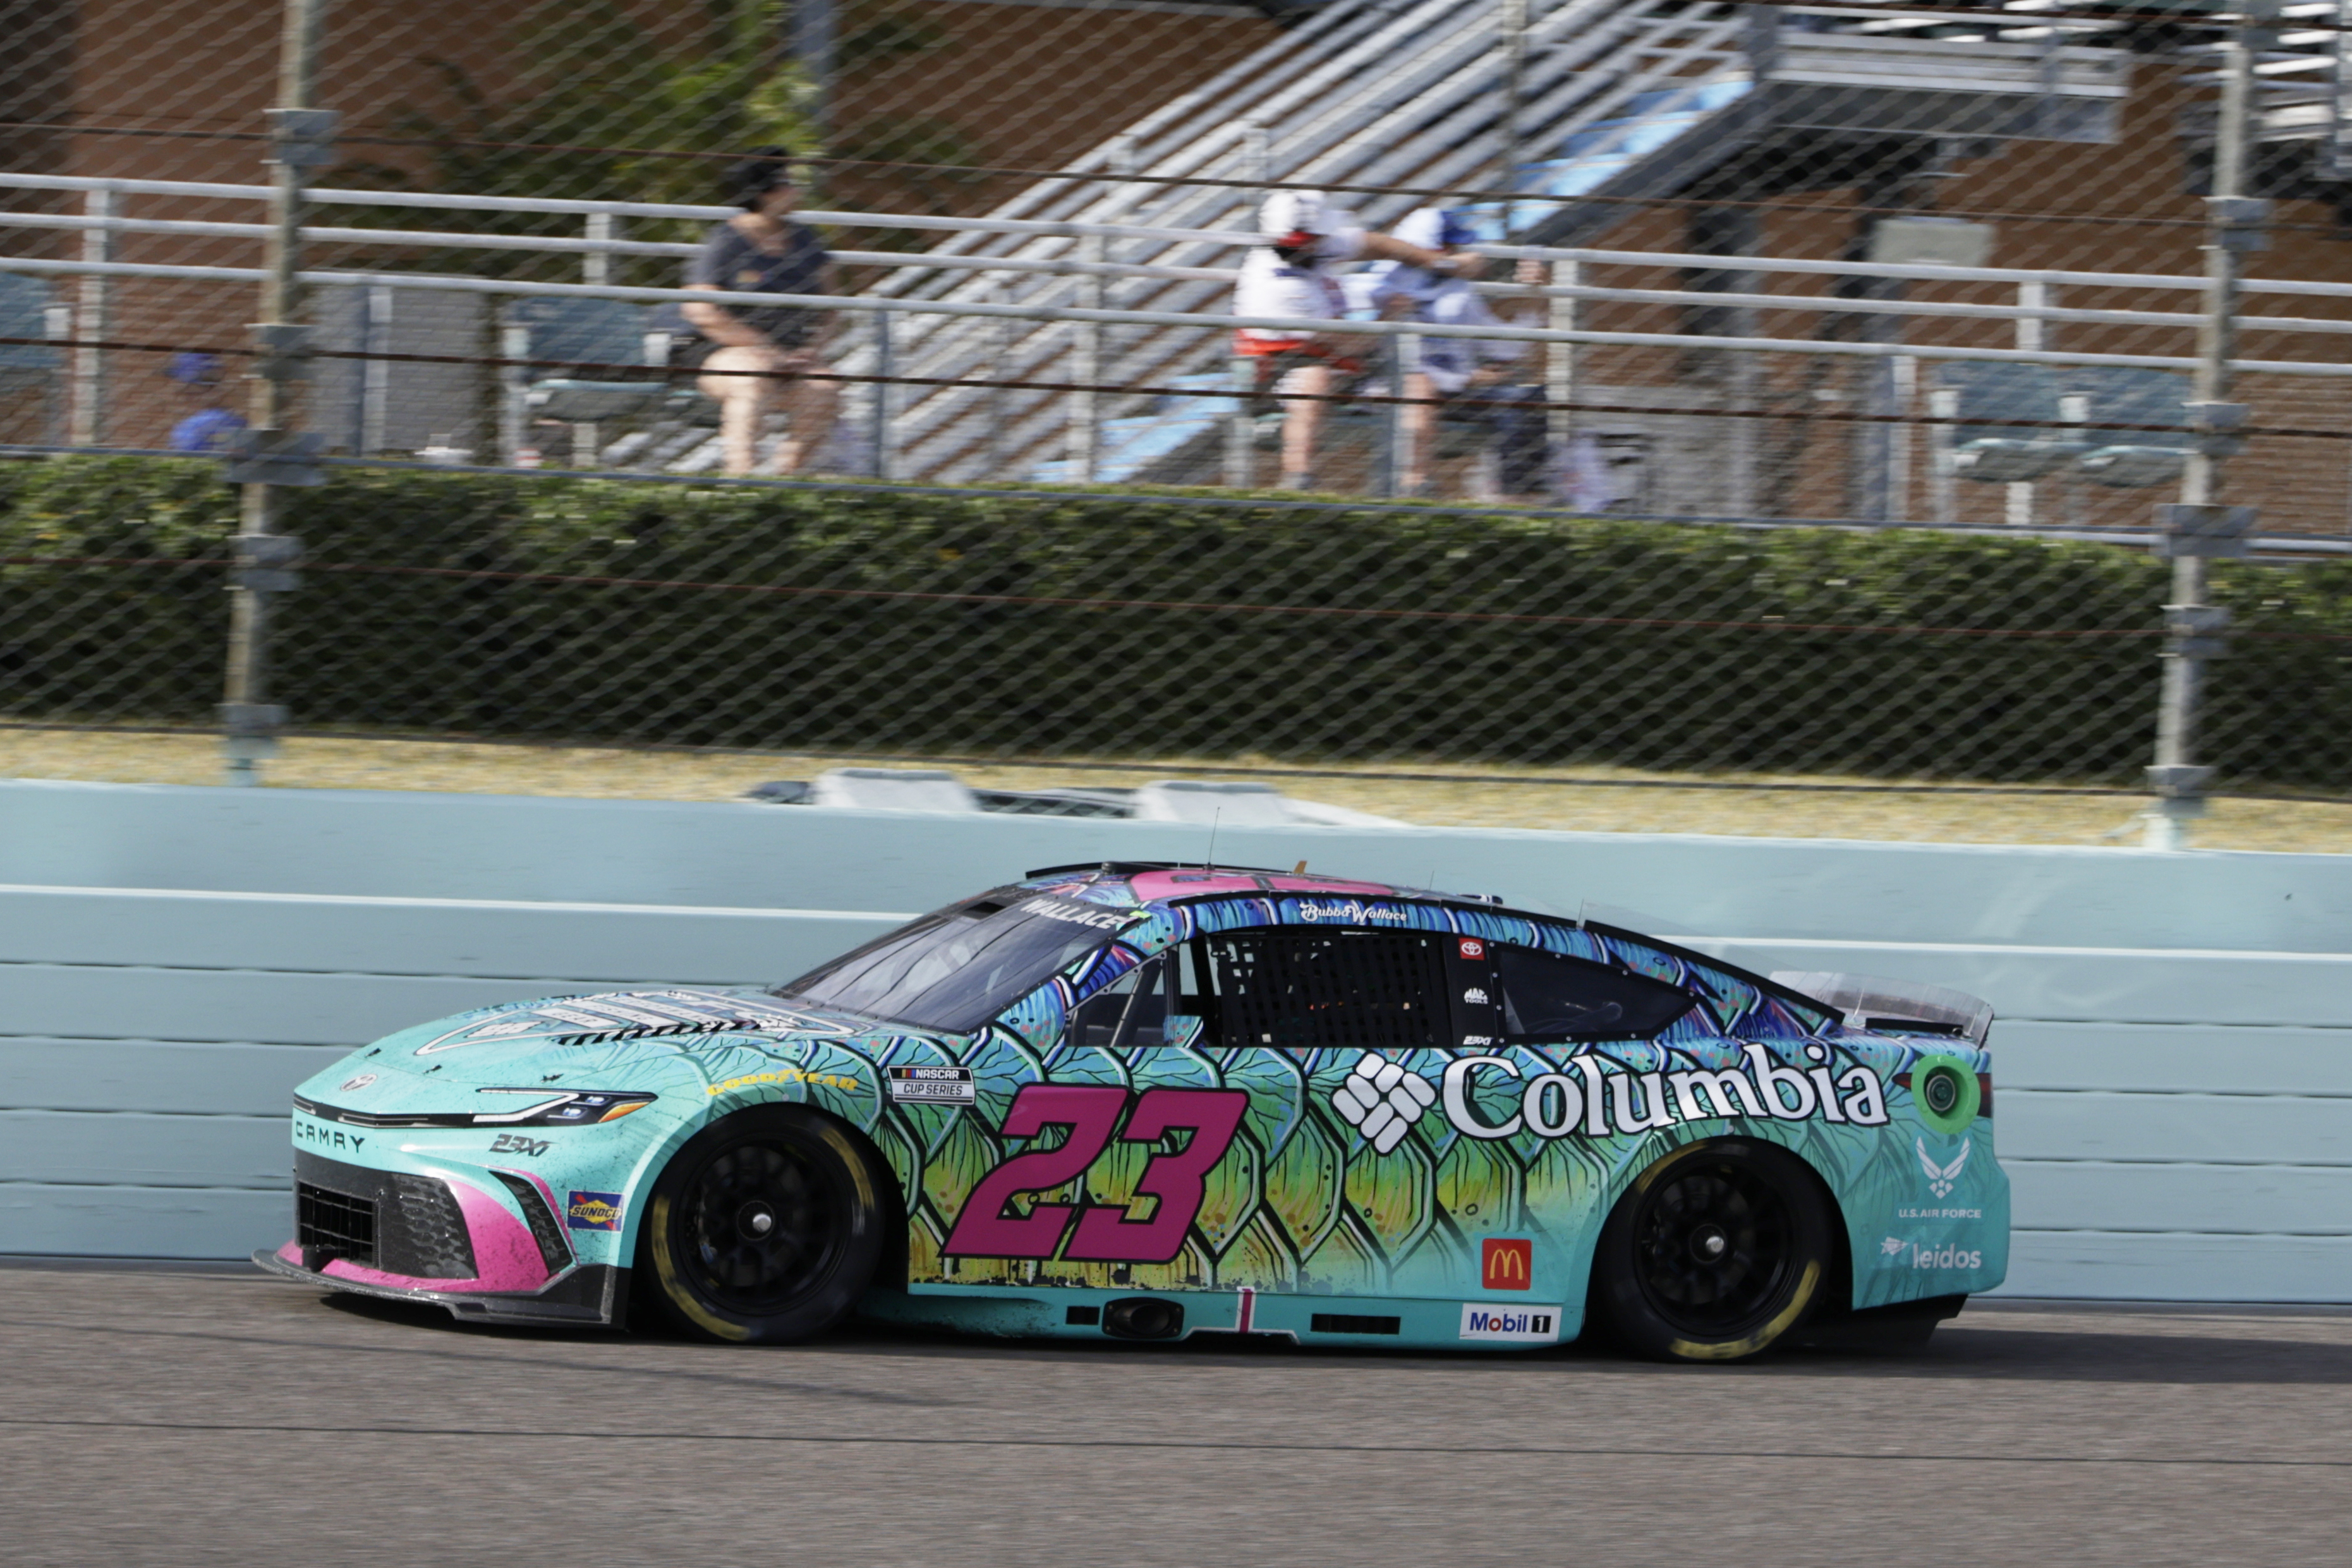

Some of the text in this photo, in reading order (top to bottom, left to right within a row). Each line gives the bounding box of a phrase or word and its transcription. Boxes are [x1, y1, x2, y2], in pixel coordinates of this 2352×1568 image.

[1020, 899, 1127, 929] WALLACE
[1299, 903, 1407, 923] Bubba Wallace
[1464, 987, 1488, 999] MAC
[706, 1069, 858, 1096] GOODYEAR
[916, 1069, 959, 1080] NASCAR
[904, 1083, 962, 1095] CUP SERIES
[1441, 1043, 1891, 1139] Columbia
[296, 1120, 365, 1154] CAMRY
[937, 1082, 1251, 1264] 23
[573, 1206, 620, 1219] SUNOCO
[1898, 1209, 1982, 1218] U.S. AIR FORCE
[1913, 1242, 1982, 1269] leidos
[1469, 1312, 1528, 1332] Mobil
